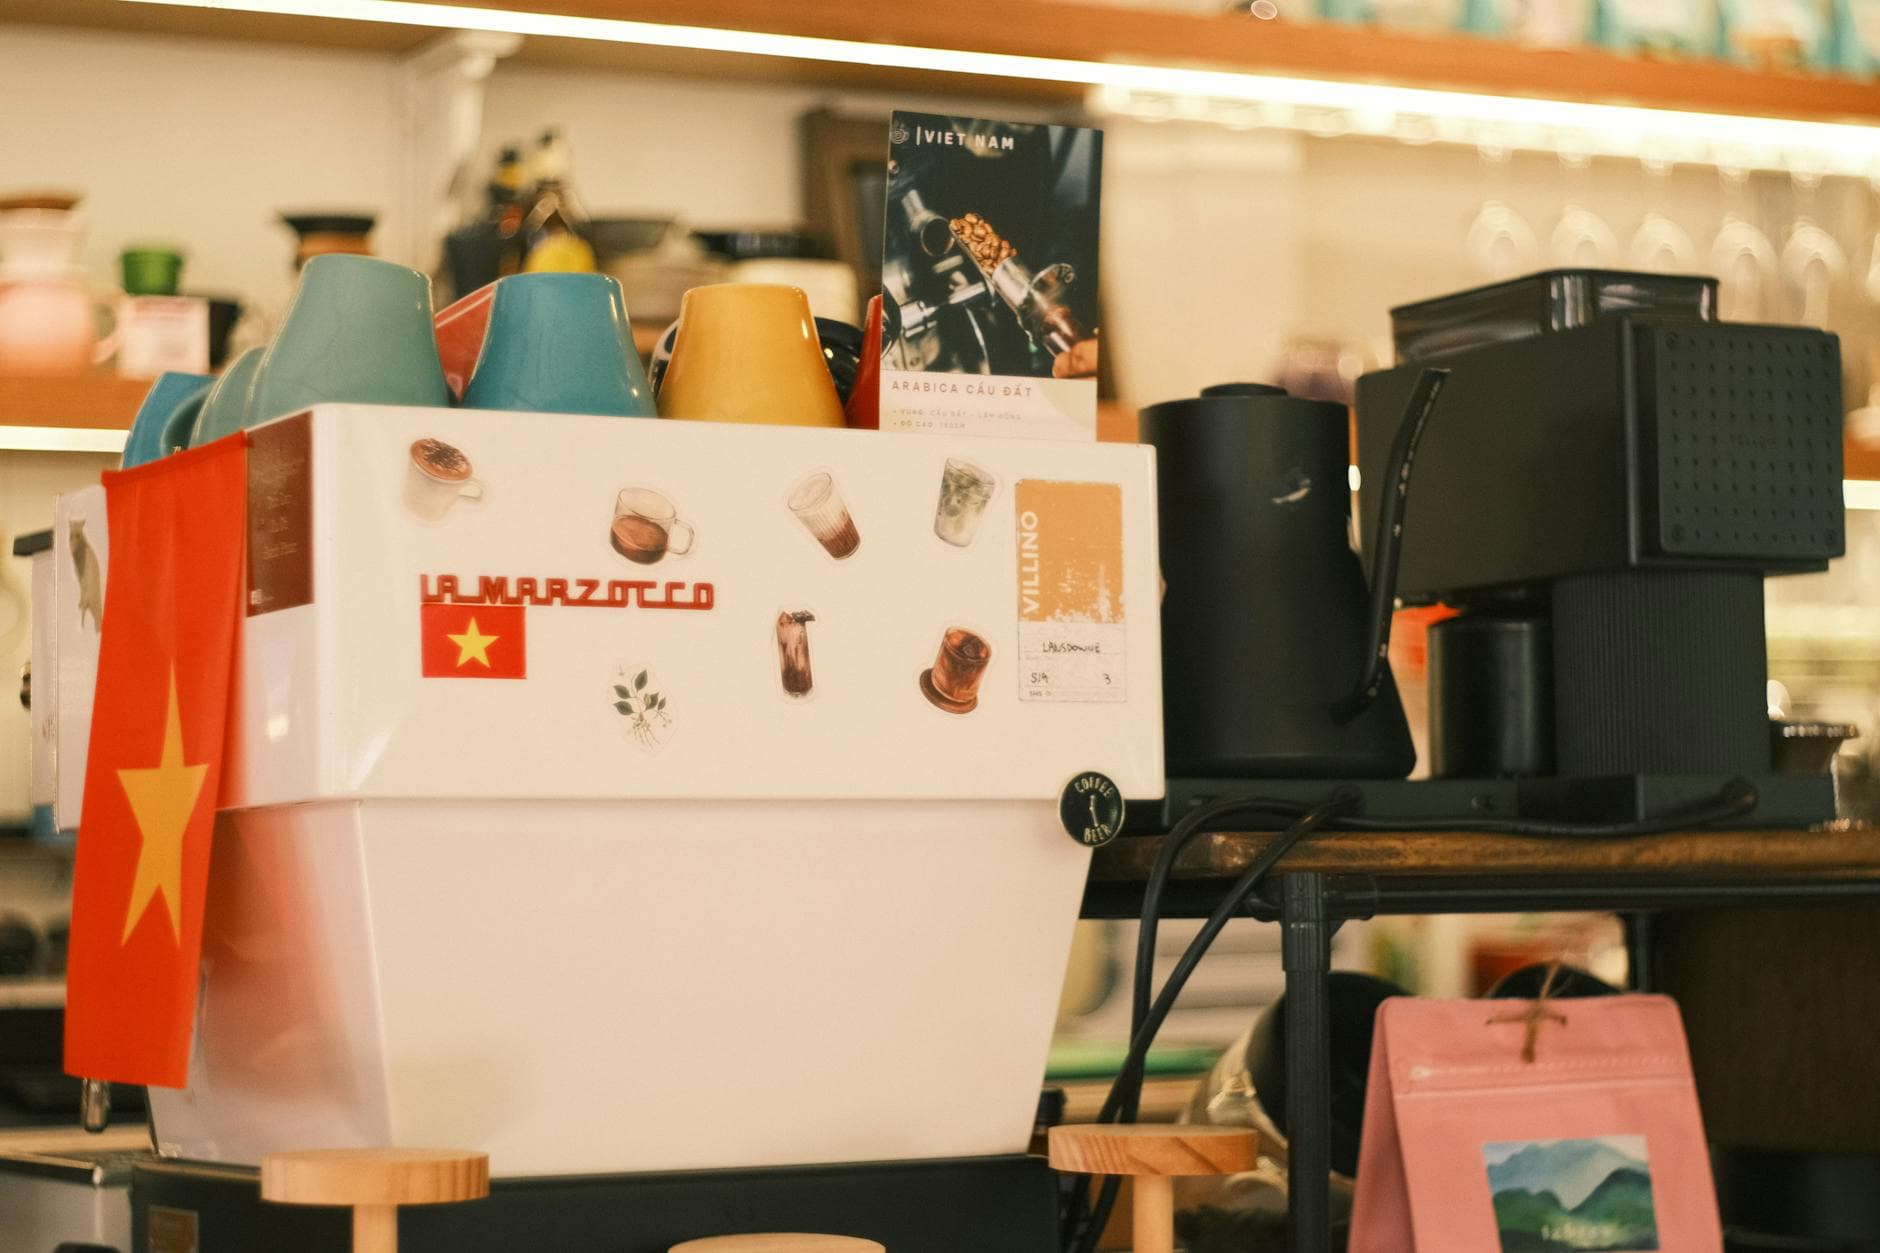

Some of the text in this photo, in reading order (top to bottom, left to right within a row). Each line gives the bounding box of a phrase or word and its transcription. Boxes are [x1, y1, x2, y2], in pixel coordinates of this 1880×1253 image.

[974, 134, 1014, 150] NAM
[890, 380, 958, 394] ARABICA
[1020, 510, 1040, 616] VILLINO
[420, 573, 715, 610] LA MARZOCCO
[1102, 672, 1112, 685] 3
[1074, 776, 1114, 798] COFFEE
[1083, 823, 1112, 843] BEER
